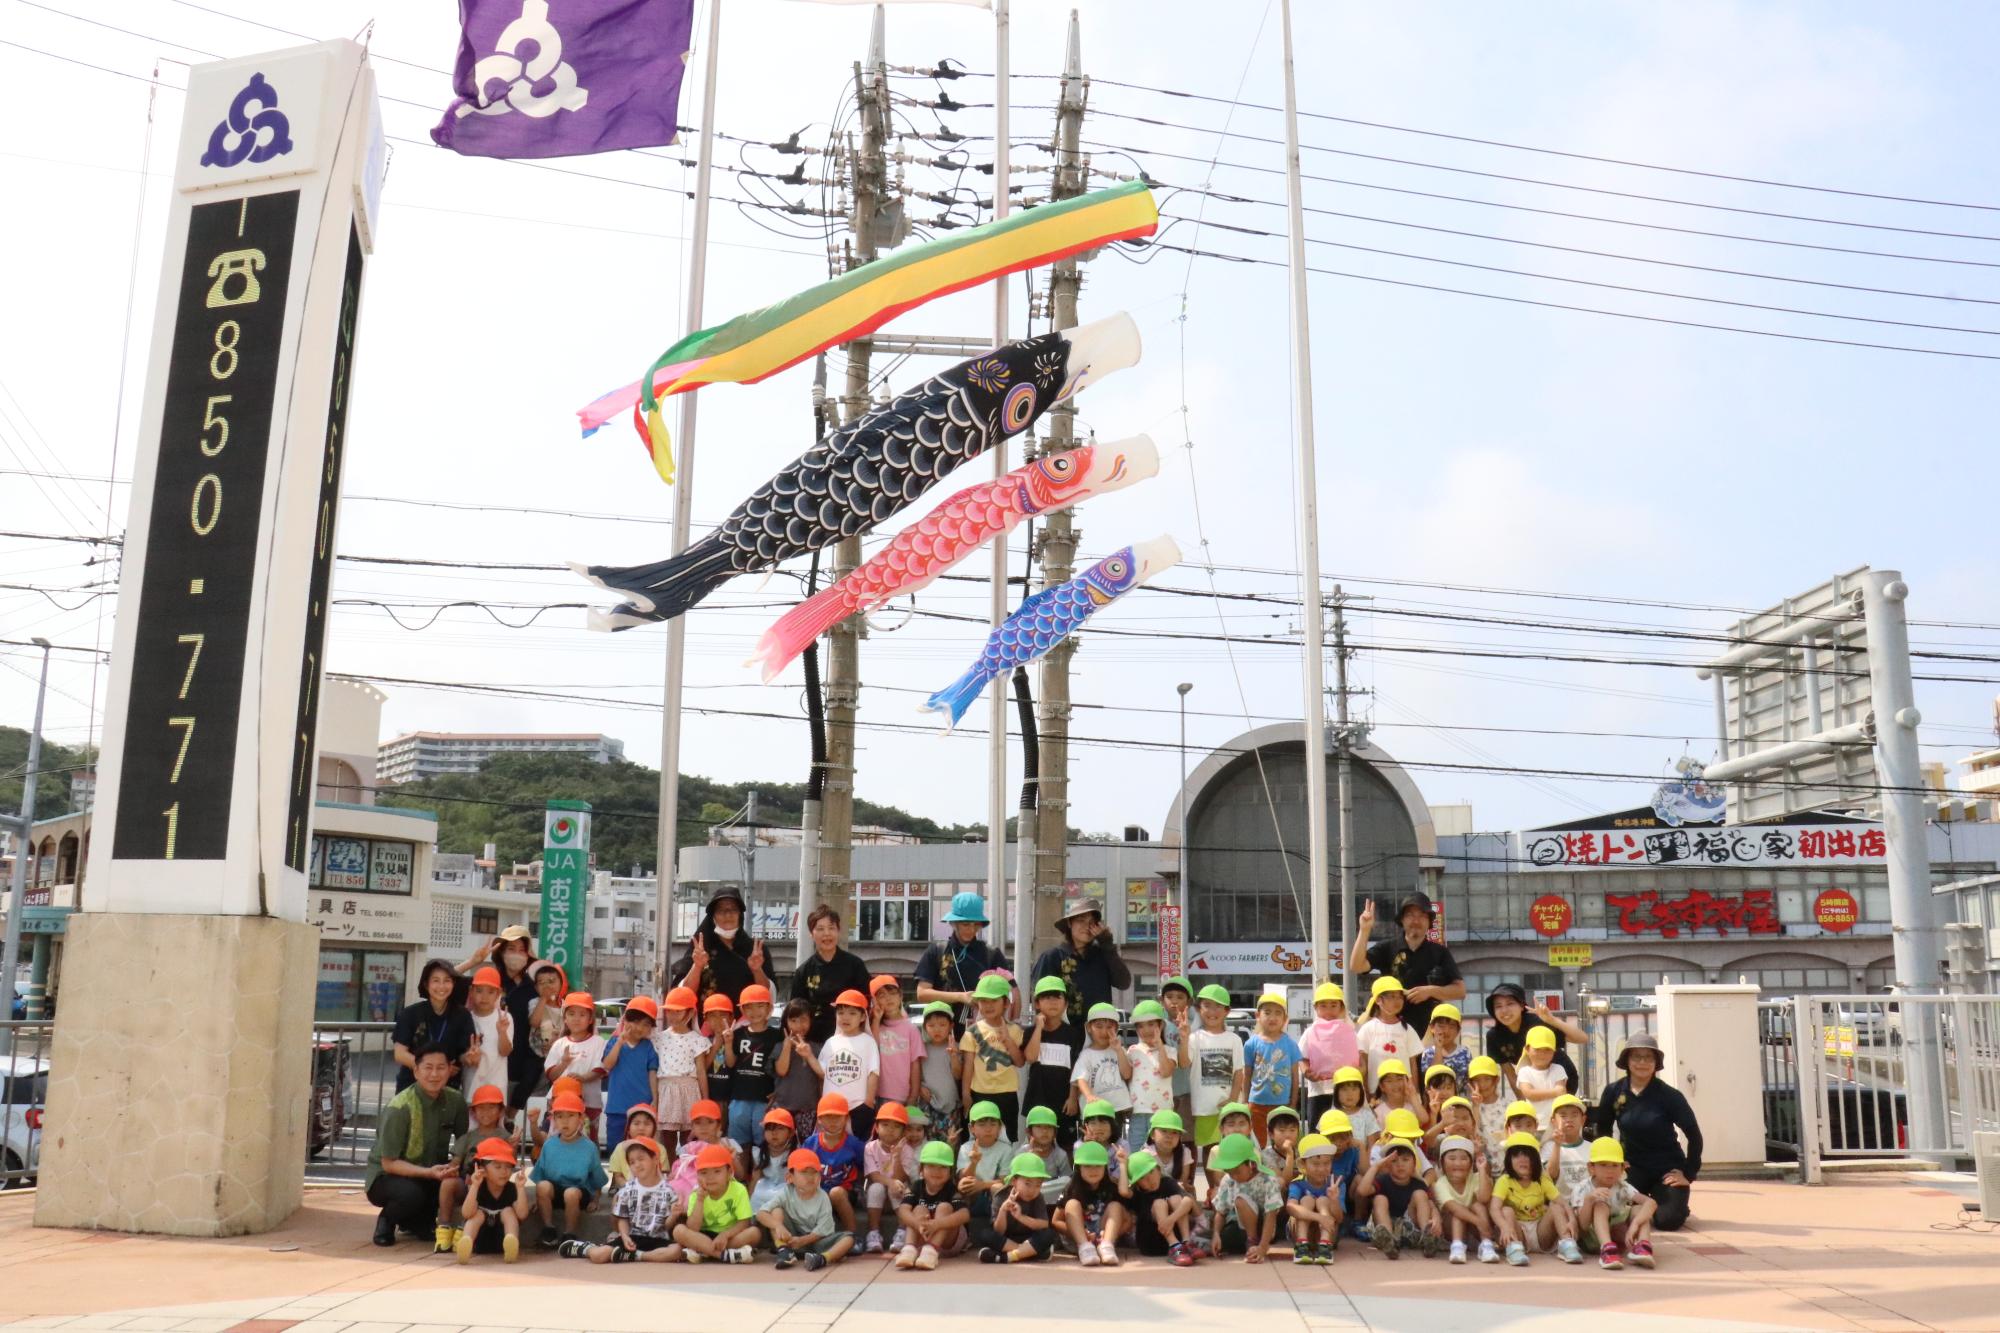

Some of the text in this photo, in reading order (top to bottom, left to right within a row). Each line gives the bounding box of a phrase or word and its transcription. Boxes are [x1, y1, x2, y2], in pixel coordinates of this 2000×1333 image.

[1798, 828, 1887, 859] 初出店
[375, 847, 408, 862] From
[547, 853, 576, 869] JA
[346, 875, 365, 886] 856
[545, 877, 572, 967] おきなわ
[1238, 953, 1269, 962] FARMERS
[739, 1039, 752, 1054] R
[751, 1052, 765, 1067] E
